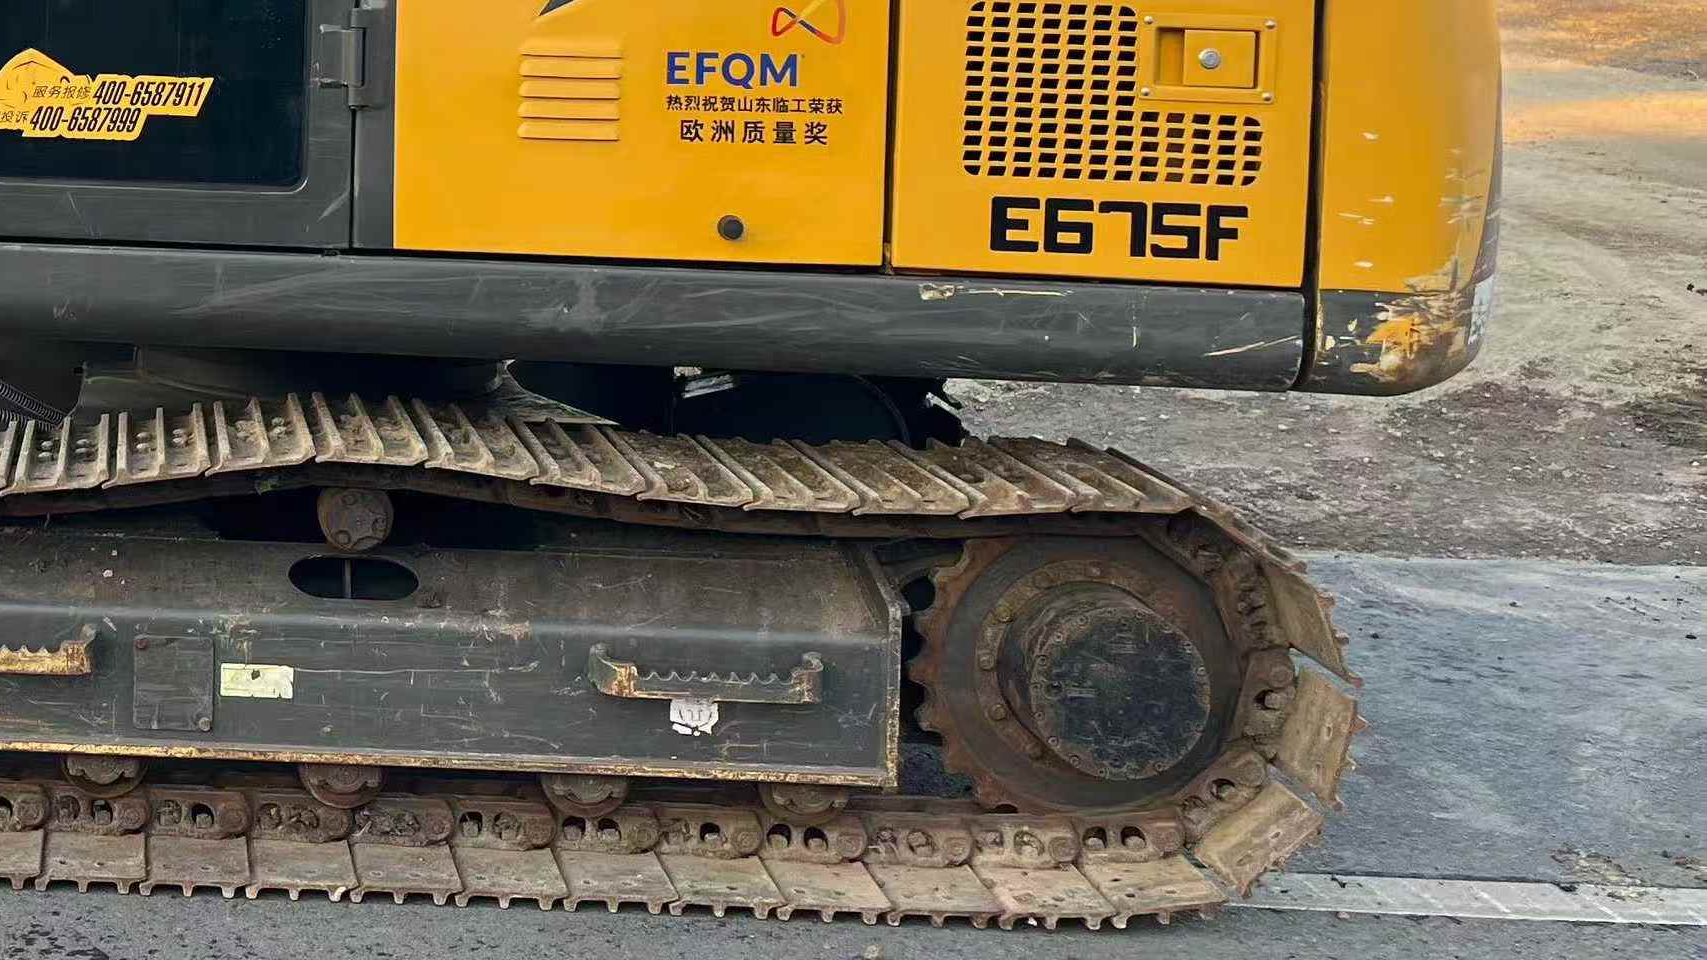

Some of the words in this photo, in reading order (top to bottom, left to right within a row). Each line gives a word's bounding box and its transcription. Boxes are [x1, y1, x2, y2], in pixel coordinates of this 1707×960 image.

[666, 51, 798, 89] EFQM
[92, 80, 206, 107] 400-6587911
[666, 94, 843, 115] 热烈祝贺山东临工荣获
[29, 106, 141, 132] 400-6587999
[680, 119, 829, 145] 欧洲质量奖
[990, 196, 1248, 261] E675F
